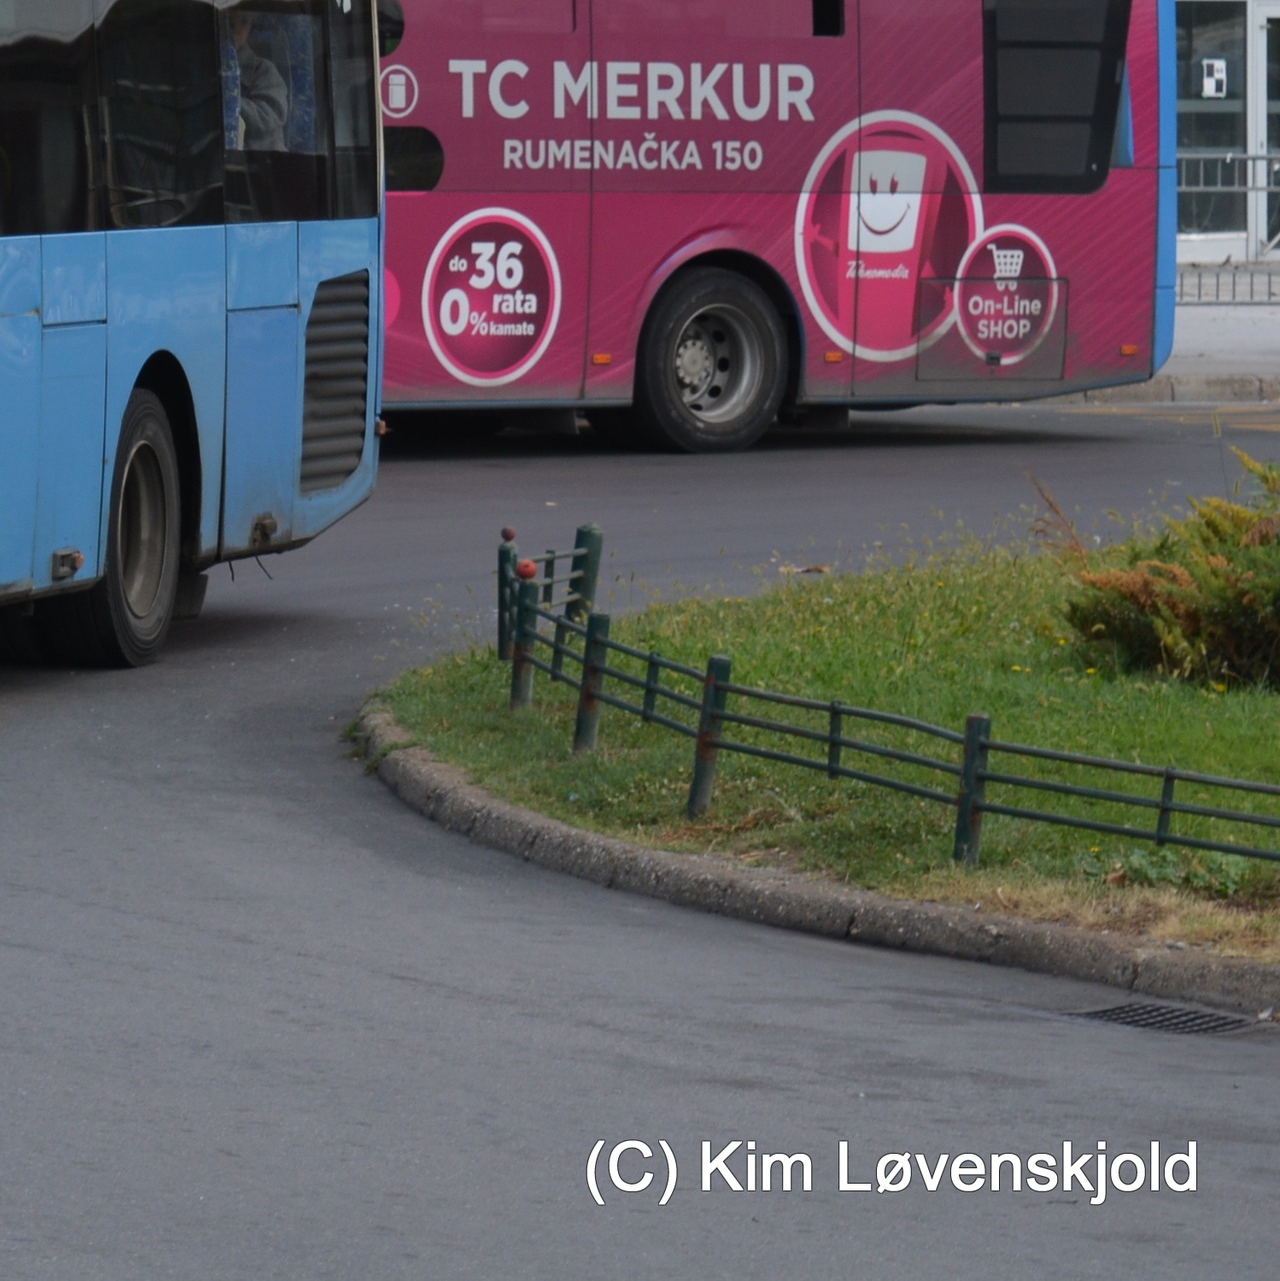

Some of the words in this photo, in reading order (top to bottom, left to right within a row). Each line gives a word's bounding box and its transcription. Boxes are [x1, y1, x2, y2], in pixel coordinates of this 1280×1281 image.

[448, 59, 530, 119] TC
[553, 60, 815, 121] MERKUR
[503, 132, 702, 170] RUMENAČKA
[711, 140, 763, 170] 150
[449, 255, 468, 272] do
[468, 241, 524, 289] 36
[492, 289, 537, 314] rata
[968, 295, 1042, 315] On-Line
[489, 321, 535, 336] kamate
[977, 319, 1031, 339] SHOP
